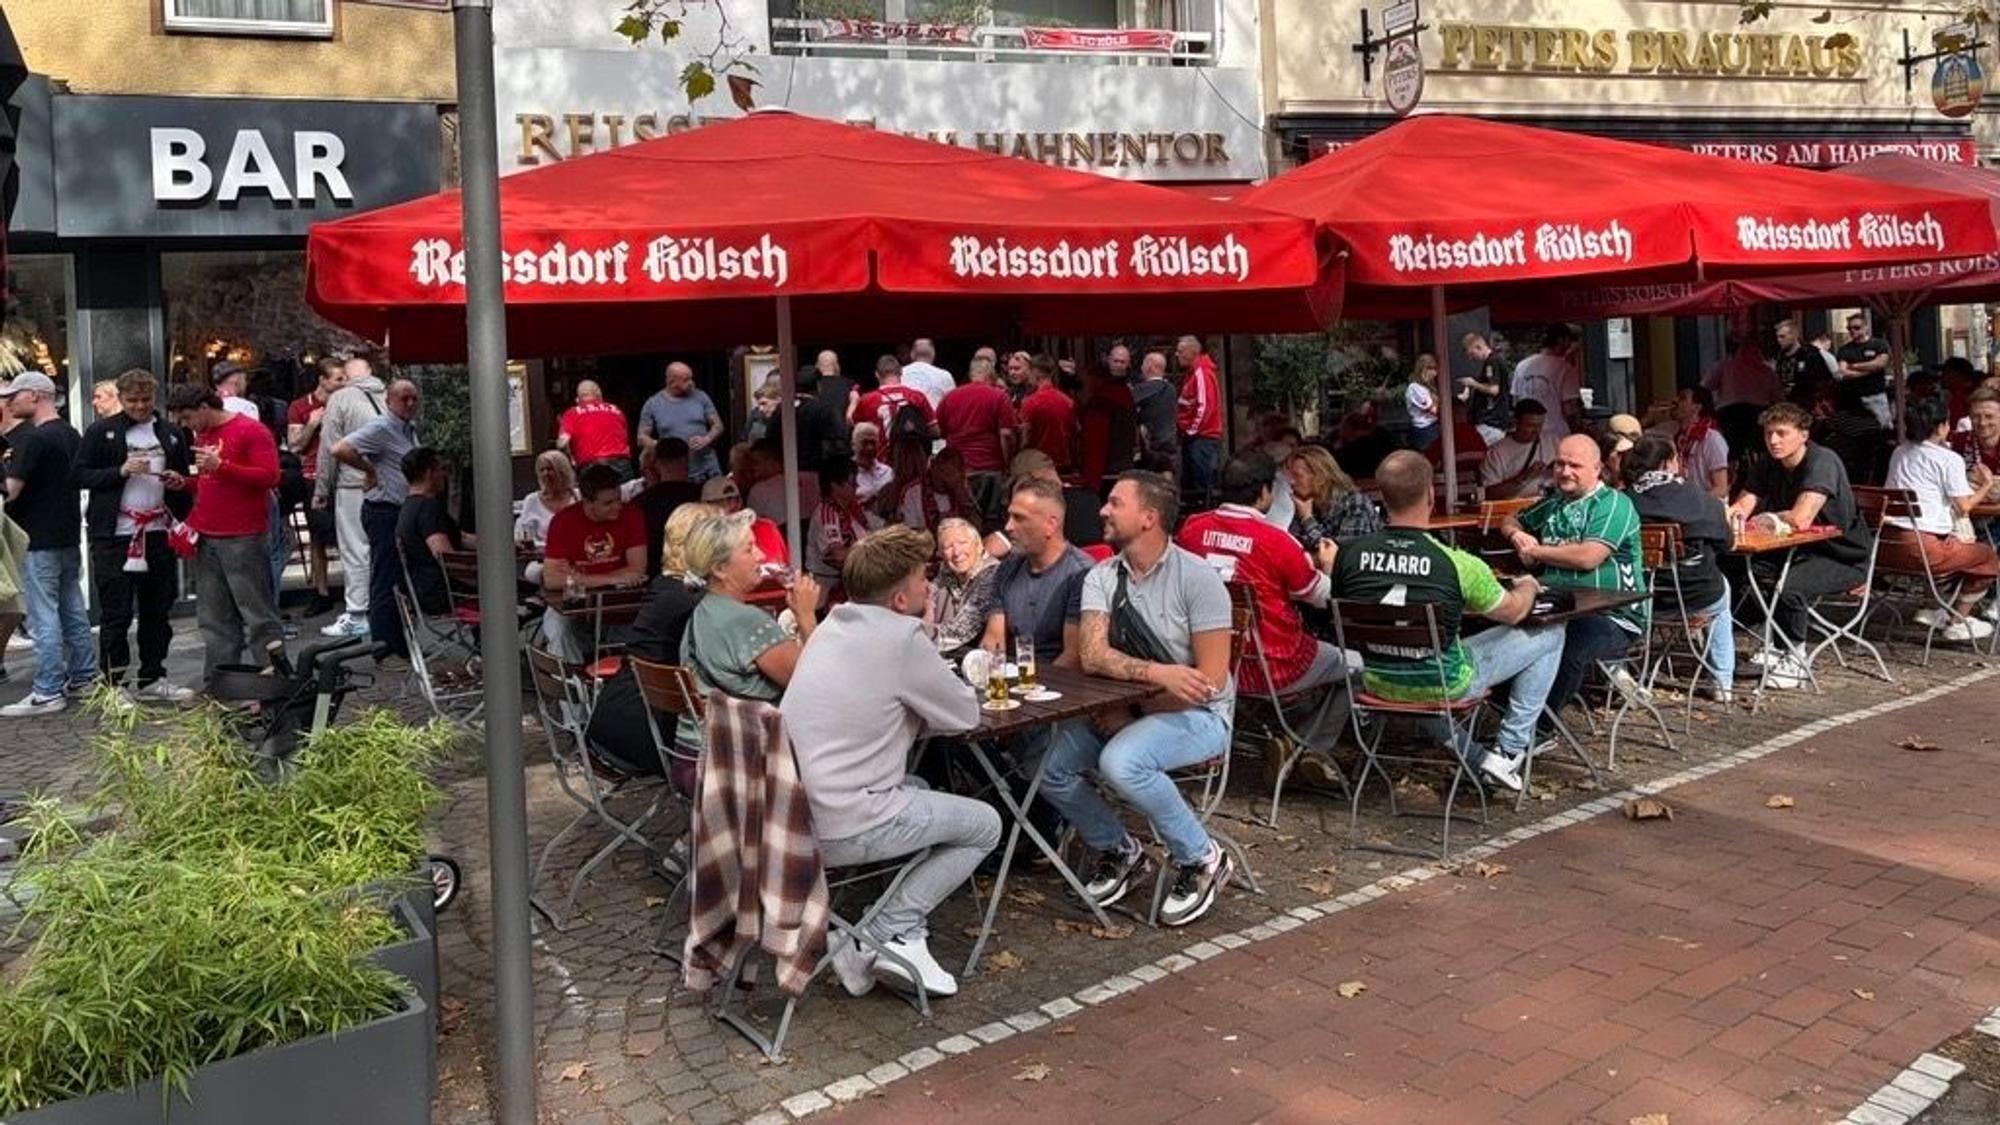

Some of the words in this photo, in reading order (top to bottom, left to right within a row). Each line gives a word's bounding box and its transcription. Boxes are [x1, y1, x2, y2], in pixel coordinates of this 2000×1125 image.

[1439, 24, 1618, 71] PETERS
[1627, 30, 1861, 76] BRAUHAUS
[150, 127, 354, 201] BAR
[976, 131, 1230, 167] HAHNENTOR
[1786, 144, 1820, 164] AM
[1389, 230, 1527, 272] Reissdorf
[1534, 219, 1632, 263] Kölsch
[1736, 215, 1851, 251] Reissdorf
[1858, 211, 1944, 252] Kölsch
[641, 233, 788, 287] Kölsch
[949, 235, 1119, 279] Reissdorf
[1129, 233, 1249, 282] Kölsch
[1360, 551, 1431, 576] PIZARRO
